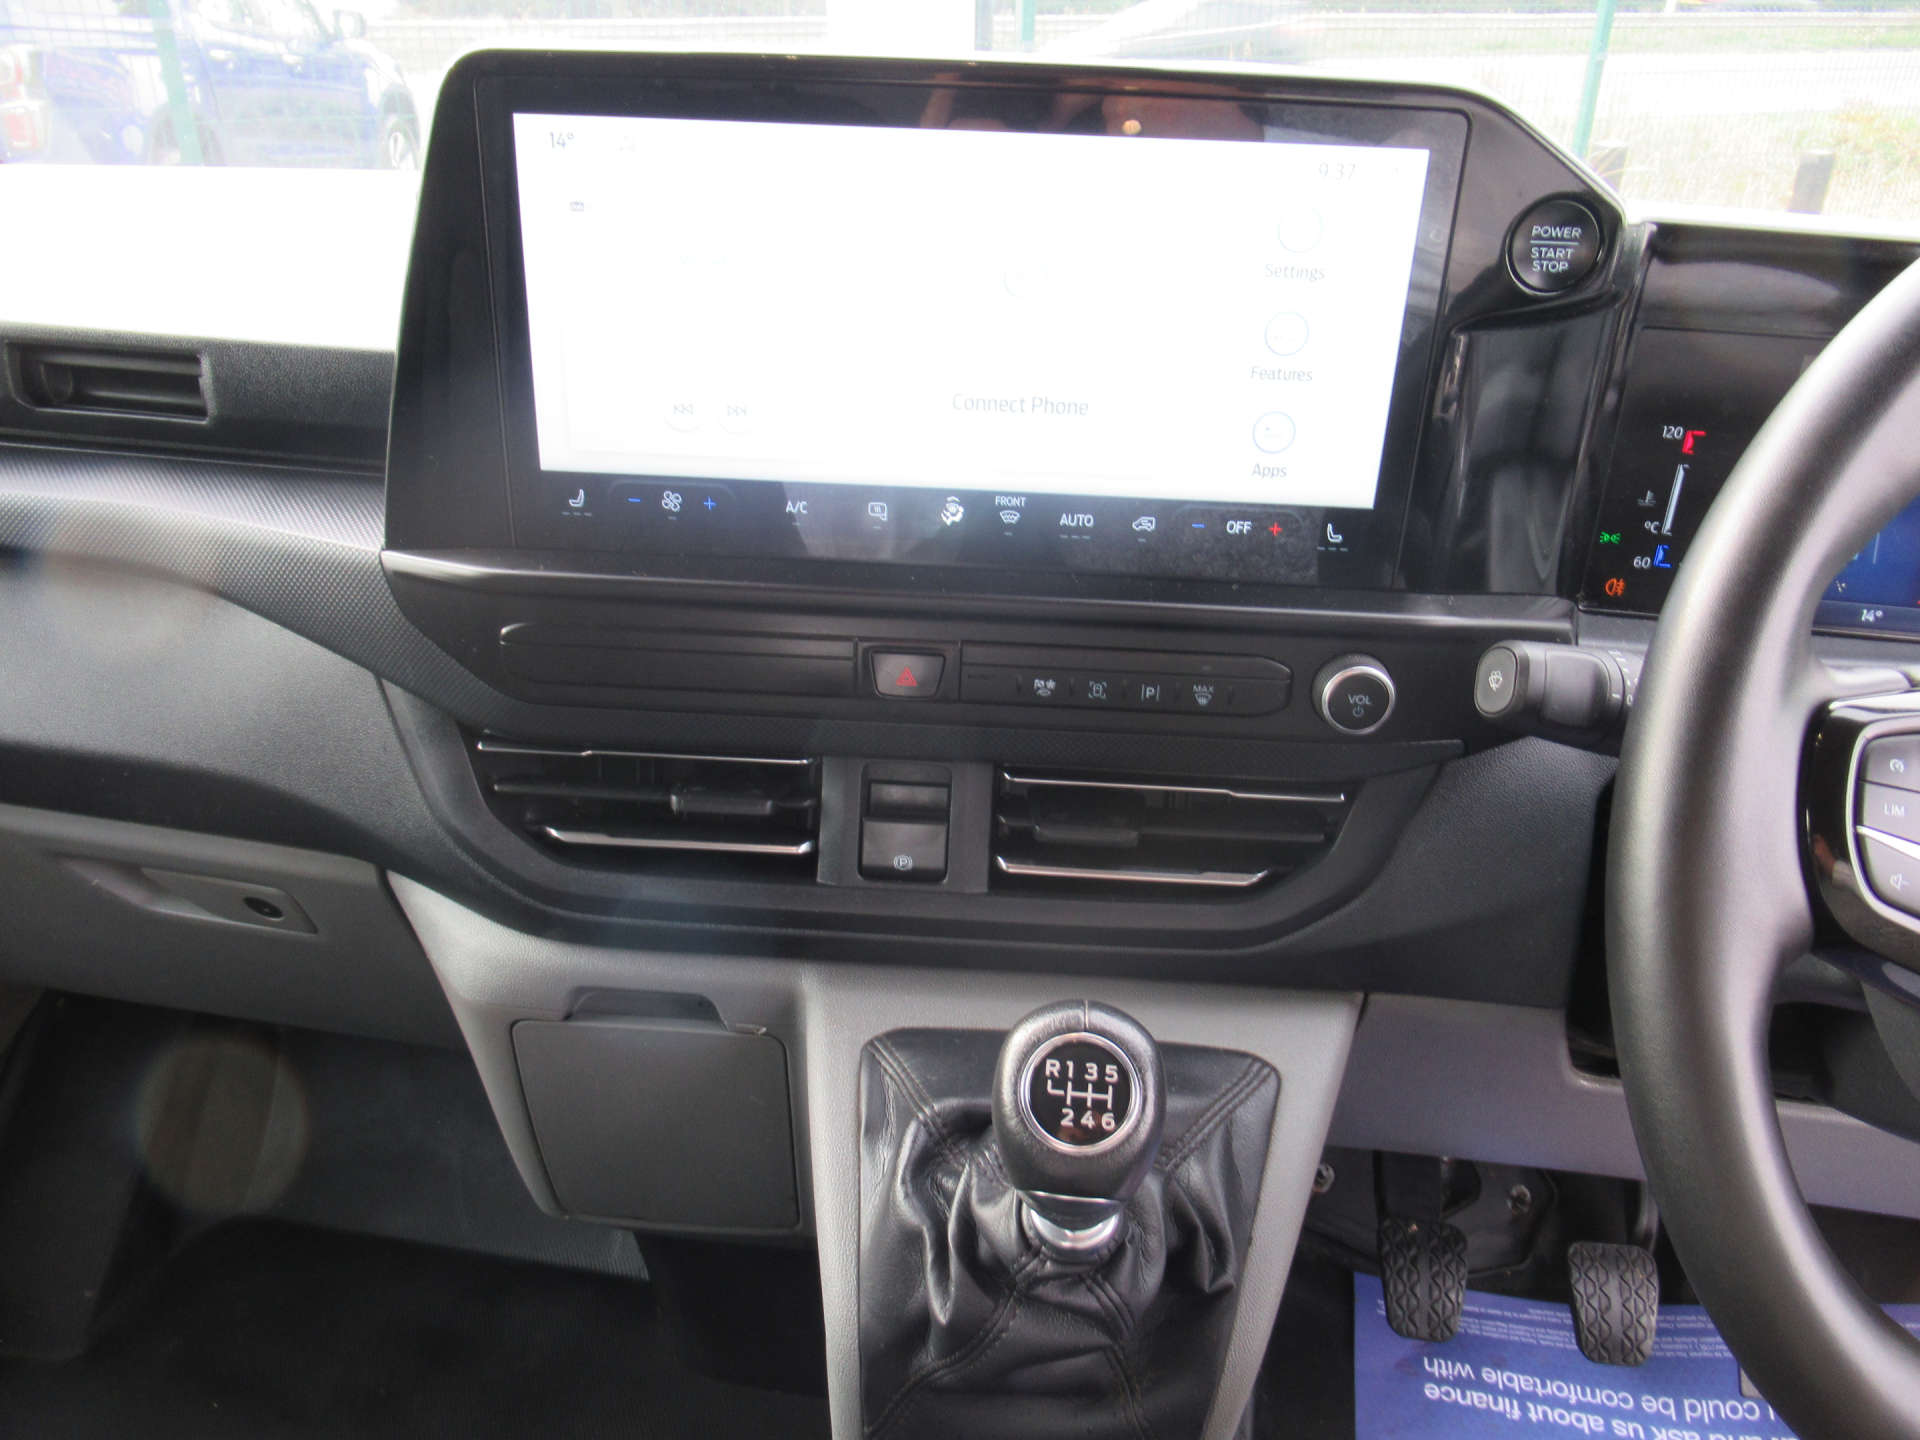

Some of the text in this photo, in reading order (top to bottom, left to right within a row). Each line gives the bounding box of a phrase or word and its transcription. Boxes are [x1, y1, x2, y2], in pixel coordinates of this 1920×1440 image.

[1531, 225, 1582, 239] POWER
[1531, 246, 1574, 260] START
[1264, 262, 1326, 283] Settings
[1532, 260, 1569, 273] STOP
[1250, 365, 1313, 382] Features
[952, 393, 1089, 416] Connect Phone
[1662, 425, 1684, 440] 120
[1251, 463, 1288, 479] Apps
[786, 499, 809, 514] A/C
[995, 496, 1026, 507] FRONT
[1060, 513, 1094, 528] AUTO
[1226, 520, 1252, 535] OFF
[1633, 556, 1651, 569] 60
[1192, 684, 1214, 694] MAX
[1347, 693, 1371, 705] VOL
[1884, 803, 1905, 818] LIM
[1423, 1356, 1476, 1382] with
[1482, 1366, 1634, 1410] comfortable
[1423, 1383, 1521, 1421] finance
[1641, 1395, 1676, 1421] be
[1526, 1402, 1605, 1434] about
[1684, 1398, 1761, 1424] could
[1611, 1419, 1645, 1440] us
